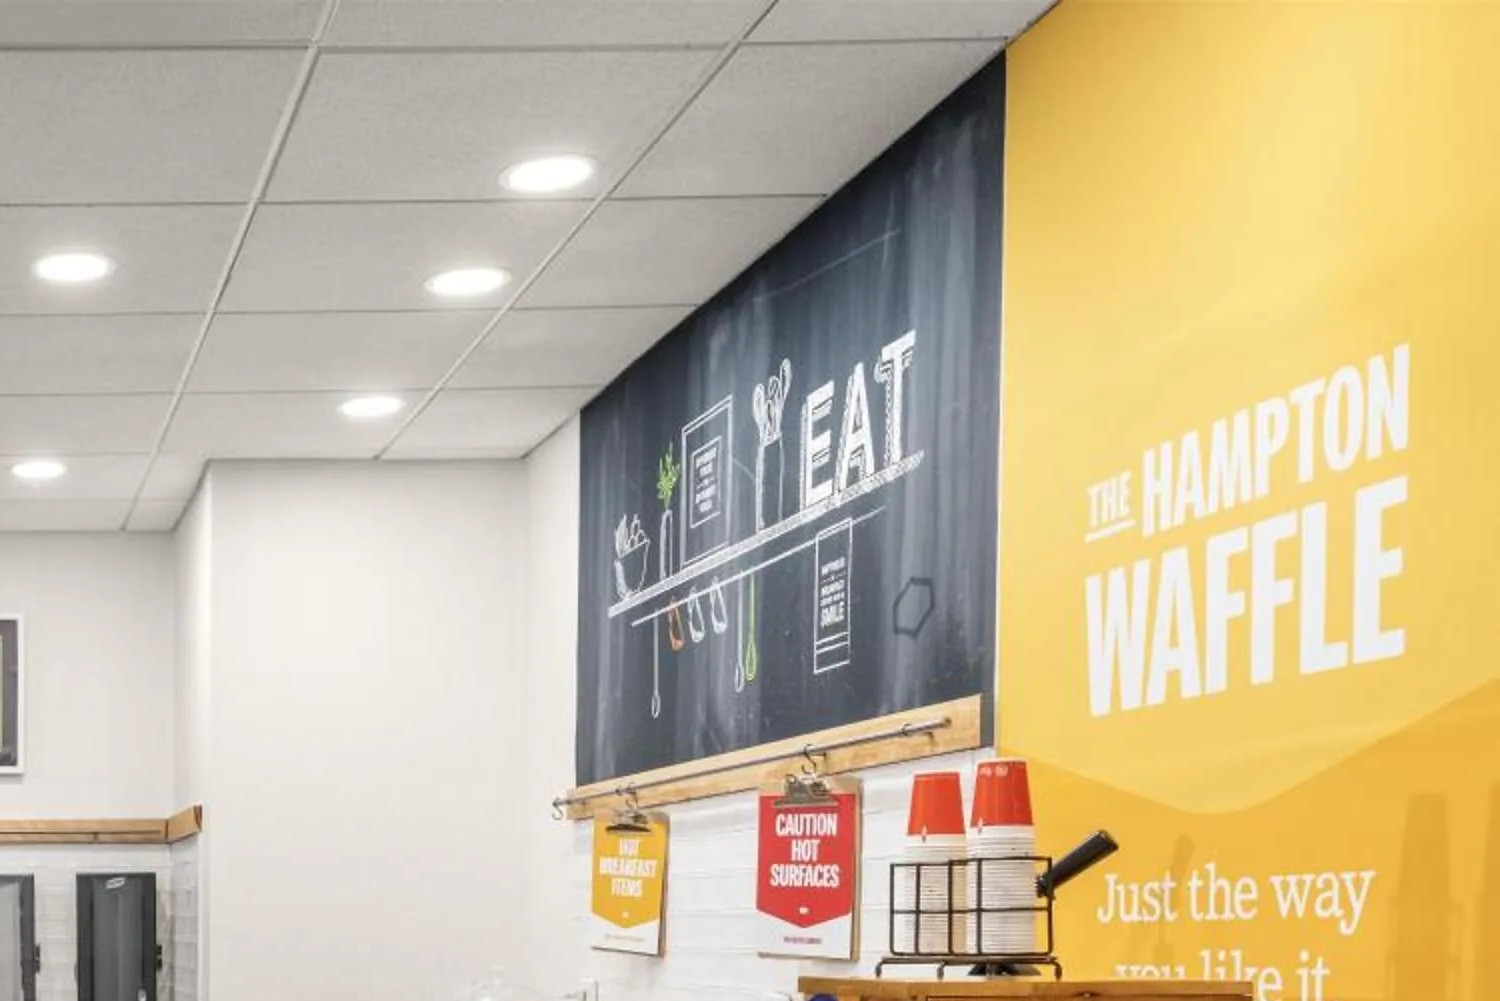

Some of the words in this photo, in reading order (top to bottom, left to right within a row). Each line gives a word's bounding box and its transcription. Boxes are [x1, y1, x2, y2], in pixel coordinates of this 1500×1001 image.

[800, 329, 917, 509] EAT
[1086, 470, 1132, 528] THE
[1141, 341, 1410, 538] HAMPTON
[1084, 475, 1408, 718] WAFFLE
[775, 813, 838, 837] CAUTION
[791, 839, 820, 862] HOT
[770, 864, 840, 888] SURFACES
[1096, 872, 1178, 924] Just
[1187, 862, 1259, 922] the
[1269, 869, 1377, 936] way
